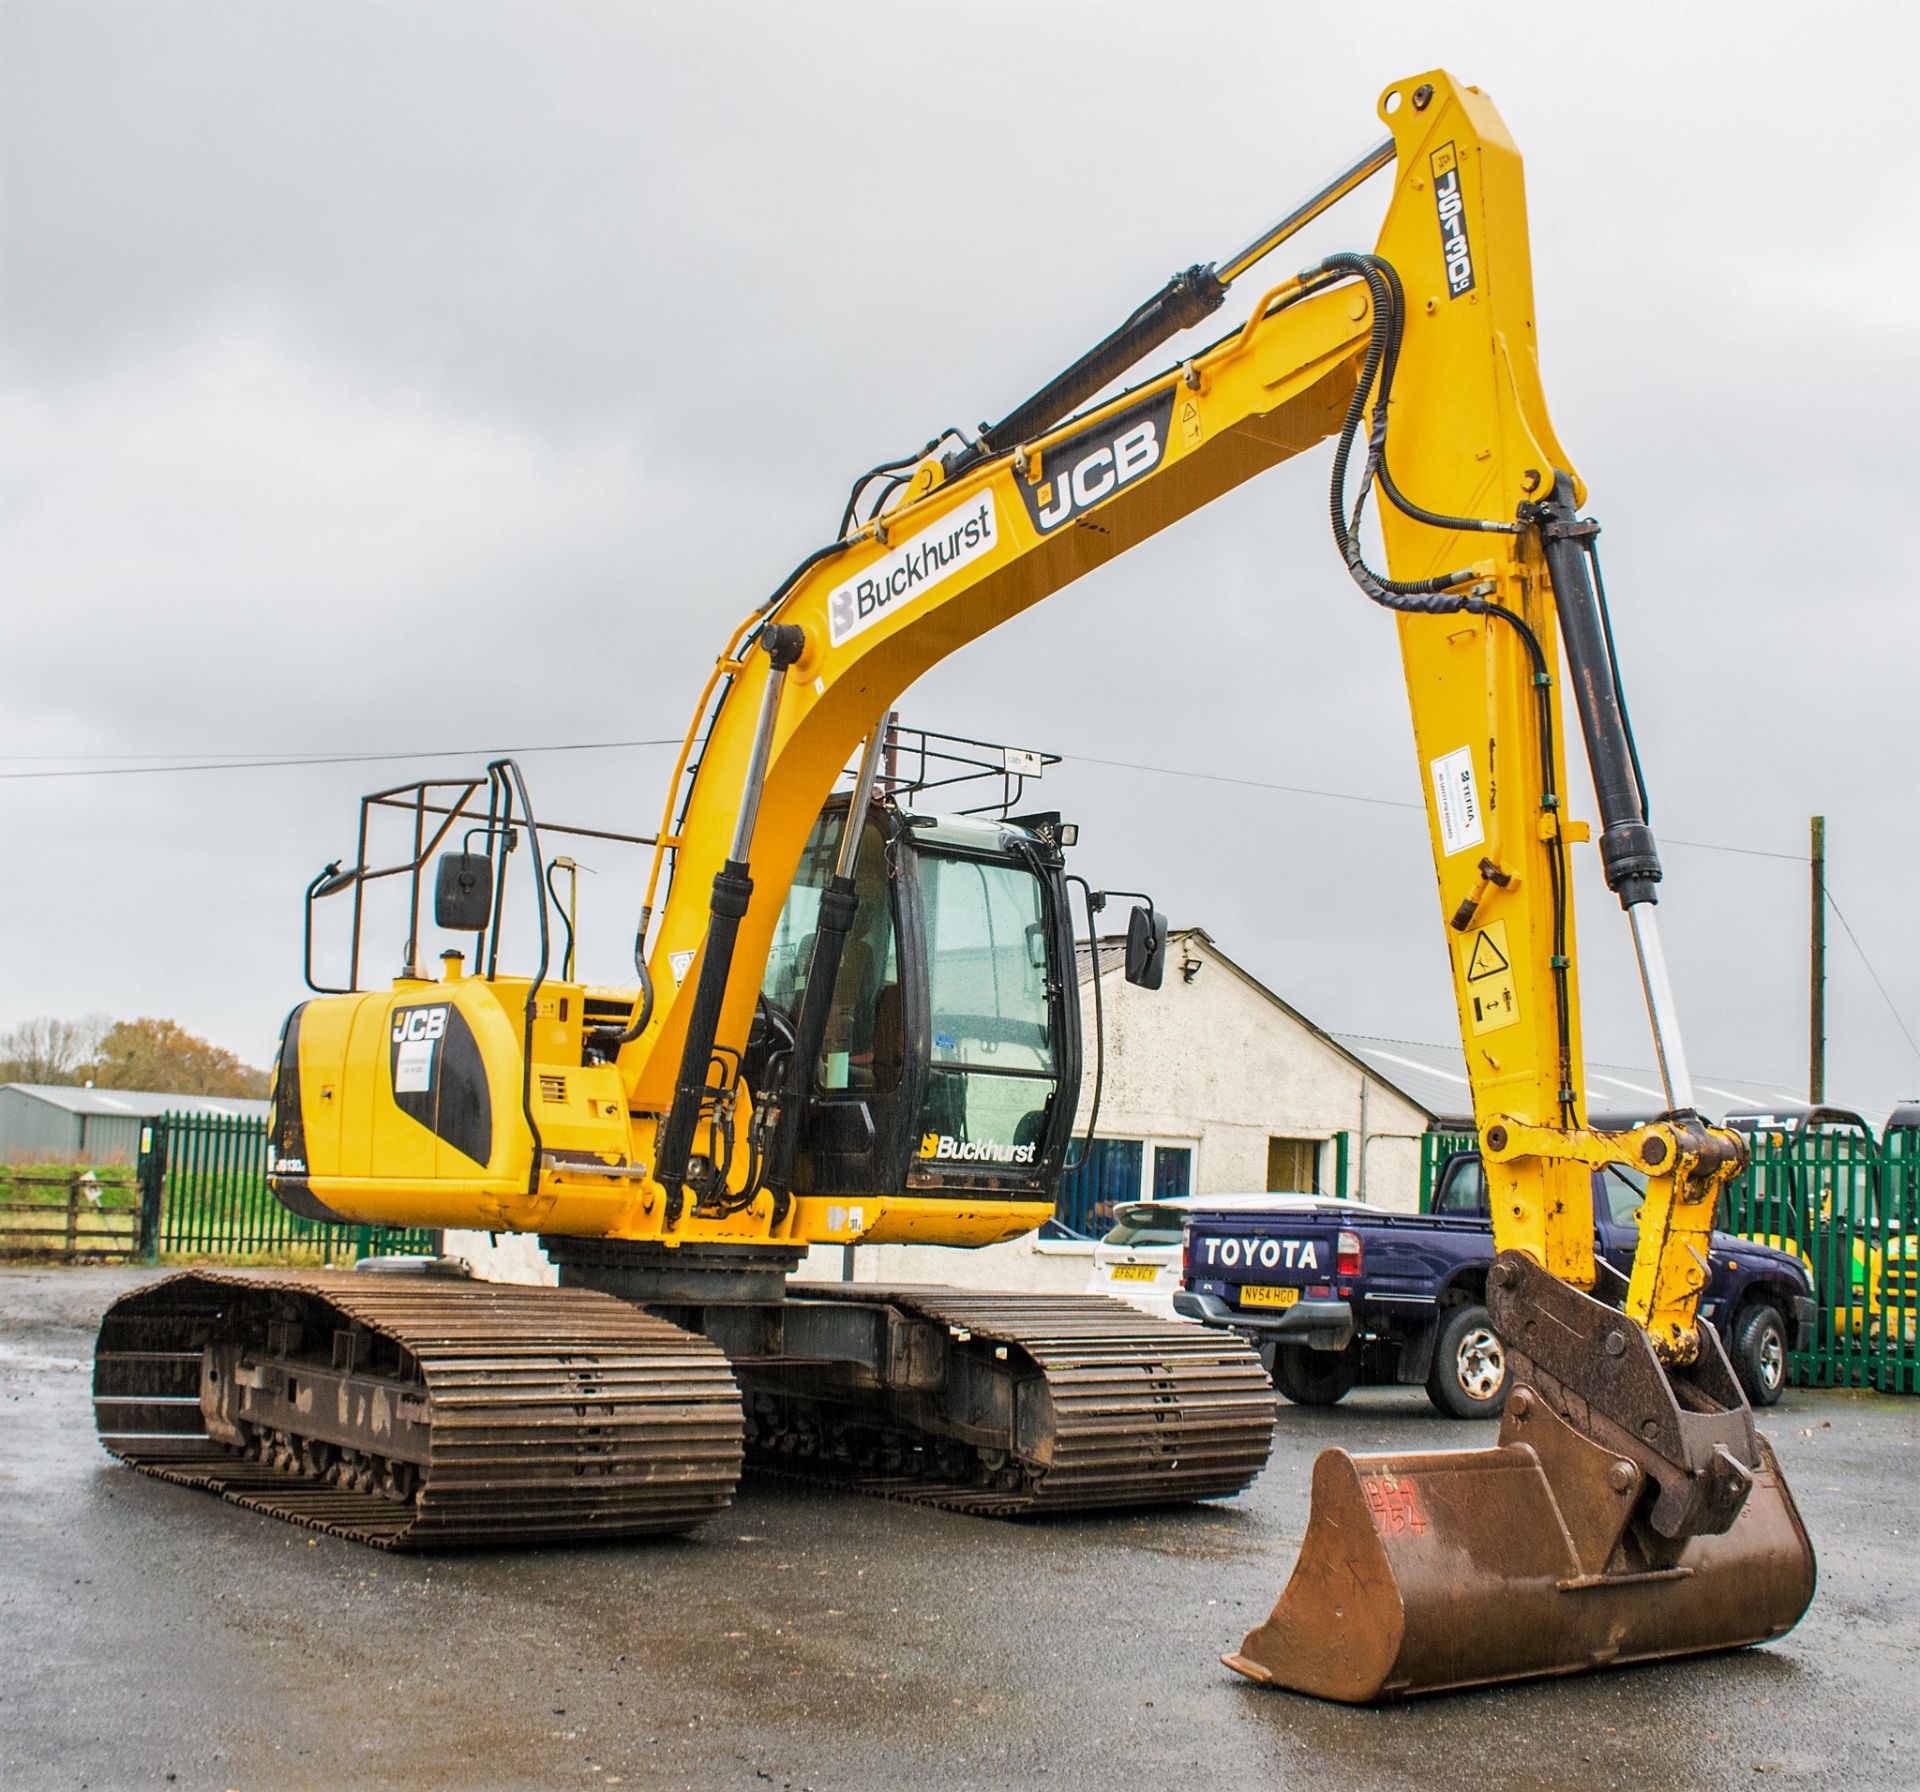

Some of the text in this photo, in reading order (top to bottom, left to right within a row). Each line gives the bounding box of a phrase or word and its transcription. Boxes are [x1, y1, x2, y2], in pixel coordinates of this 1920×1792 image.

[1039, 420, 1160, 529] JCB
[855, 504, 992, 619] Buckhurst
[392, 1007, 447, 1043] JCB
[936, 1135, 1036, 1163] Buckhurst
[1205, 1238, 1318, 1270] TOYOTA
[1245, 1286, 1271, 1300] NV54
